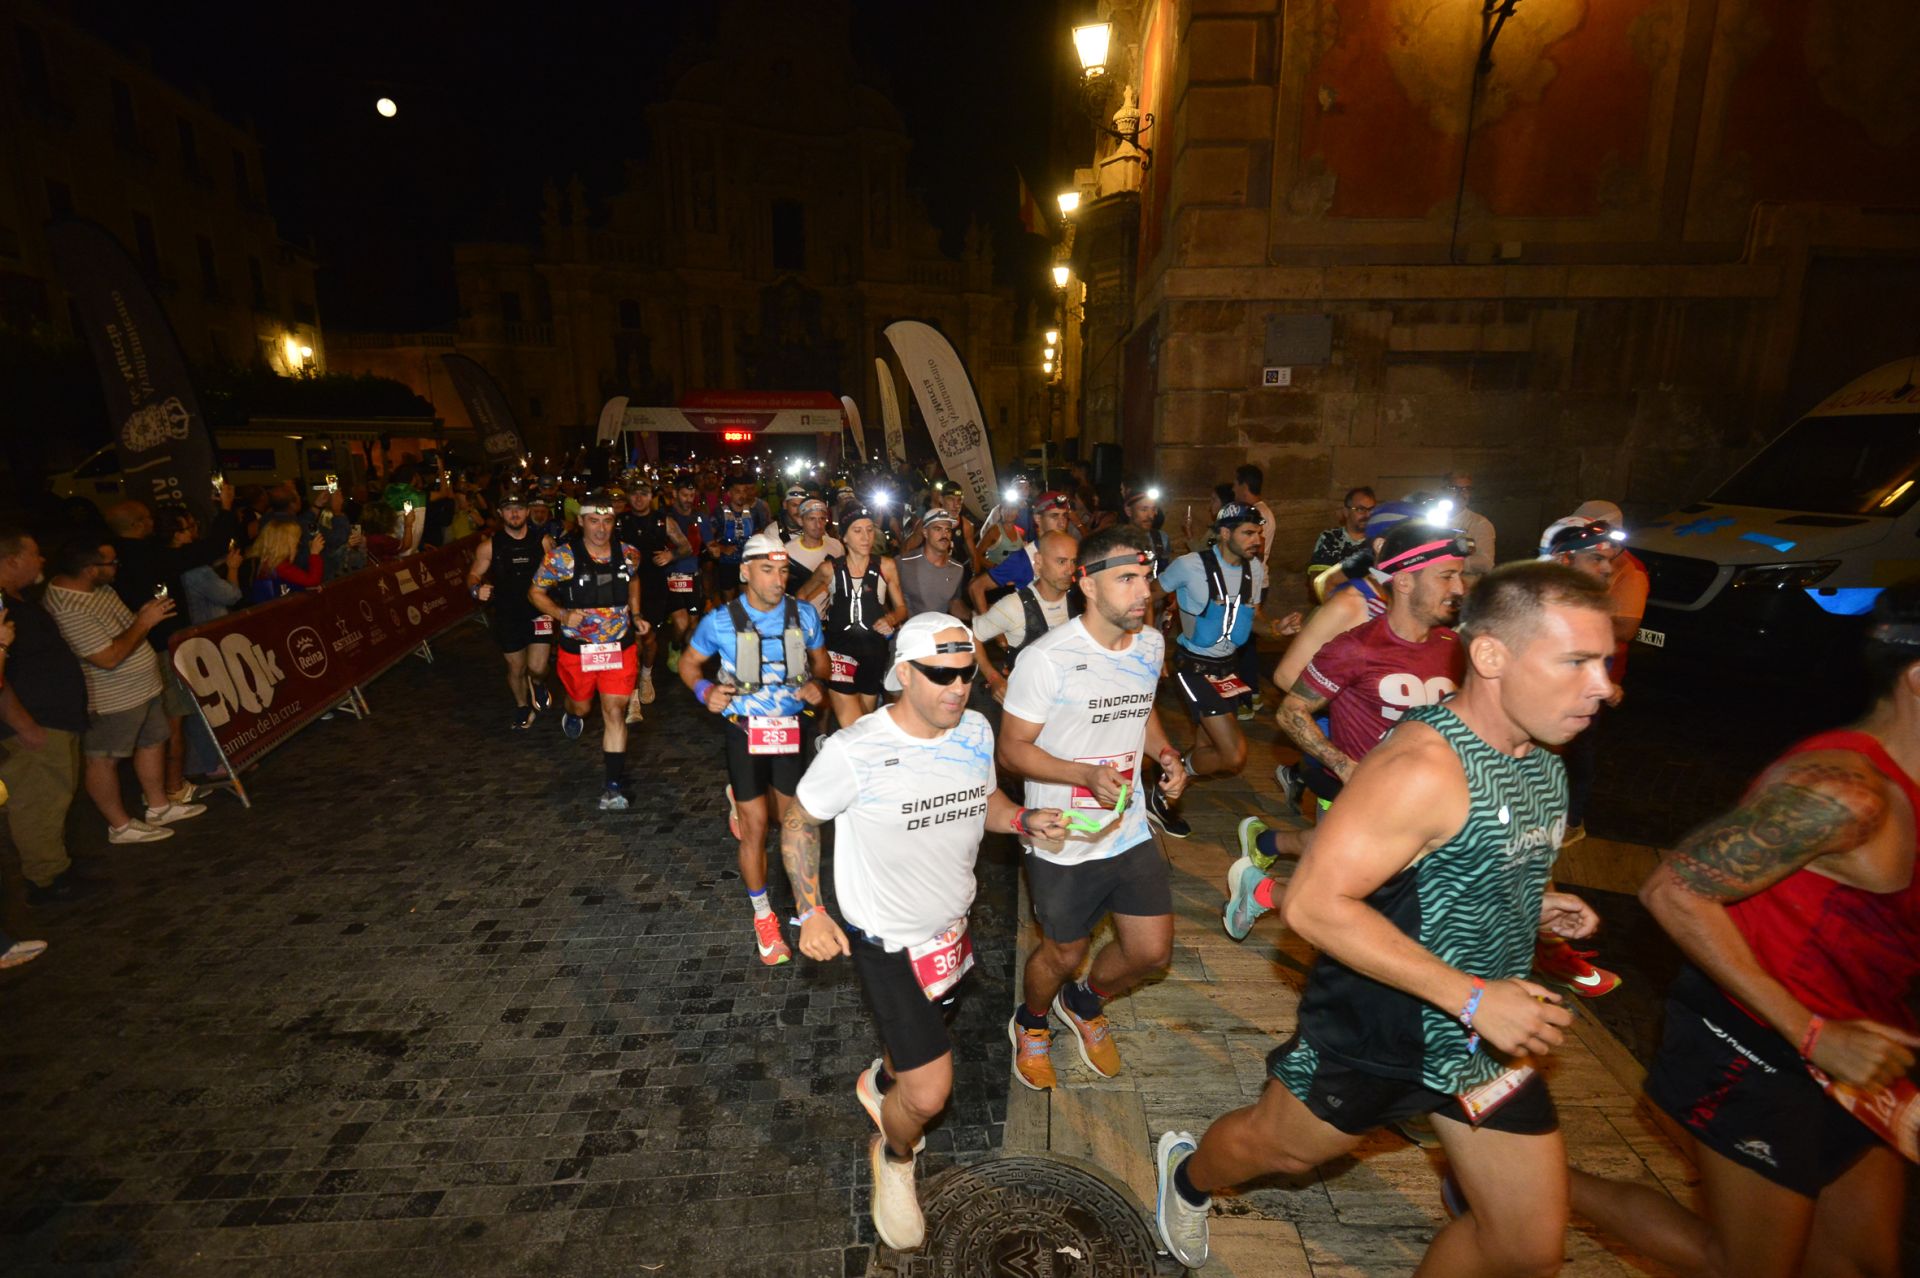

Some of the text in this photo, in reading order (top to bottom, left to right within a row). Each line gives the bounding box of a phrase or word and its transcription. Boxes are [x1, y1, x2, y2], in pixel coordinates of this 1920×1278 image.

[298, 650, 325, 670] Reina
[592, 653, 612, 663] 357
[223, 700, 302, 756] amino de la cruz
[1091, 712, 1110, 724] DE
[762, 731, 788, 743] 253
[906, 803, 987, 831] DE USHER
[933, 942, 963, 976] 367
